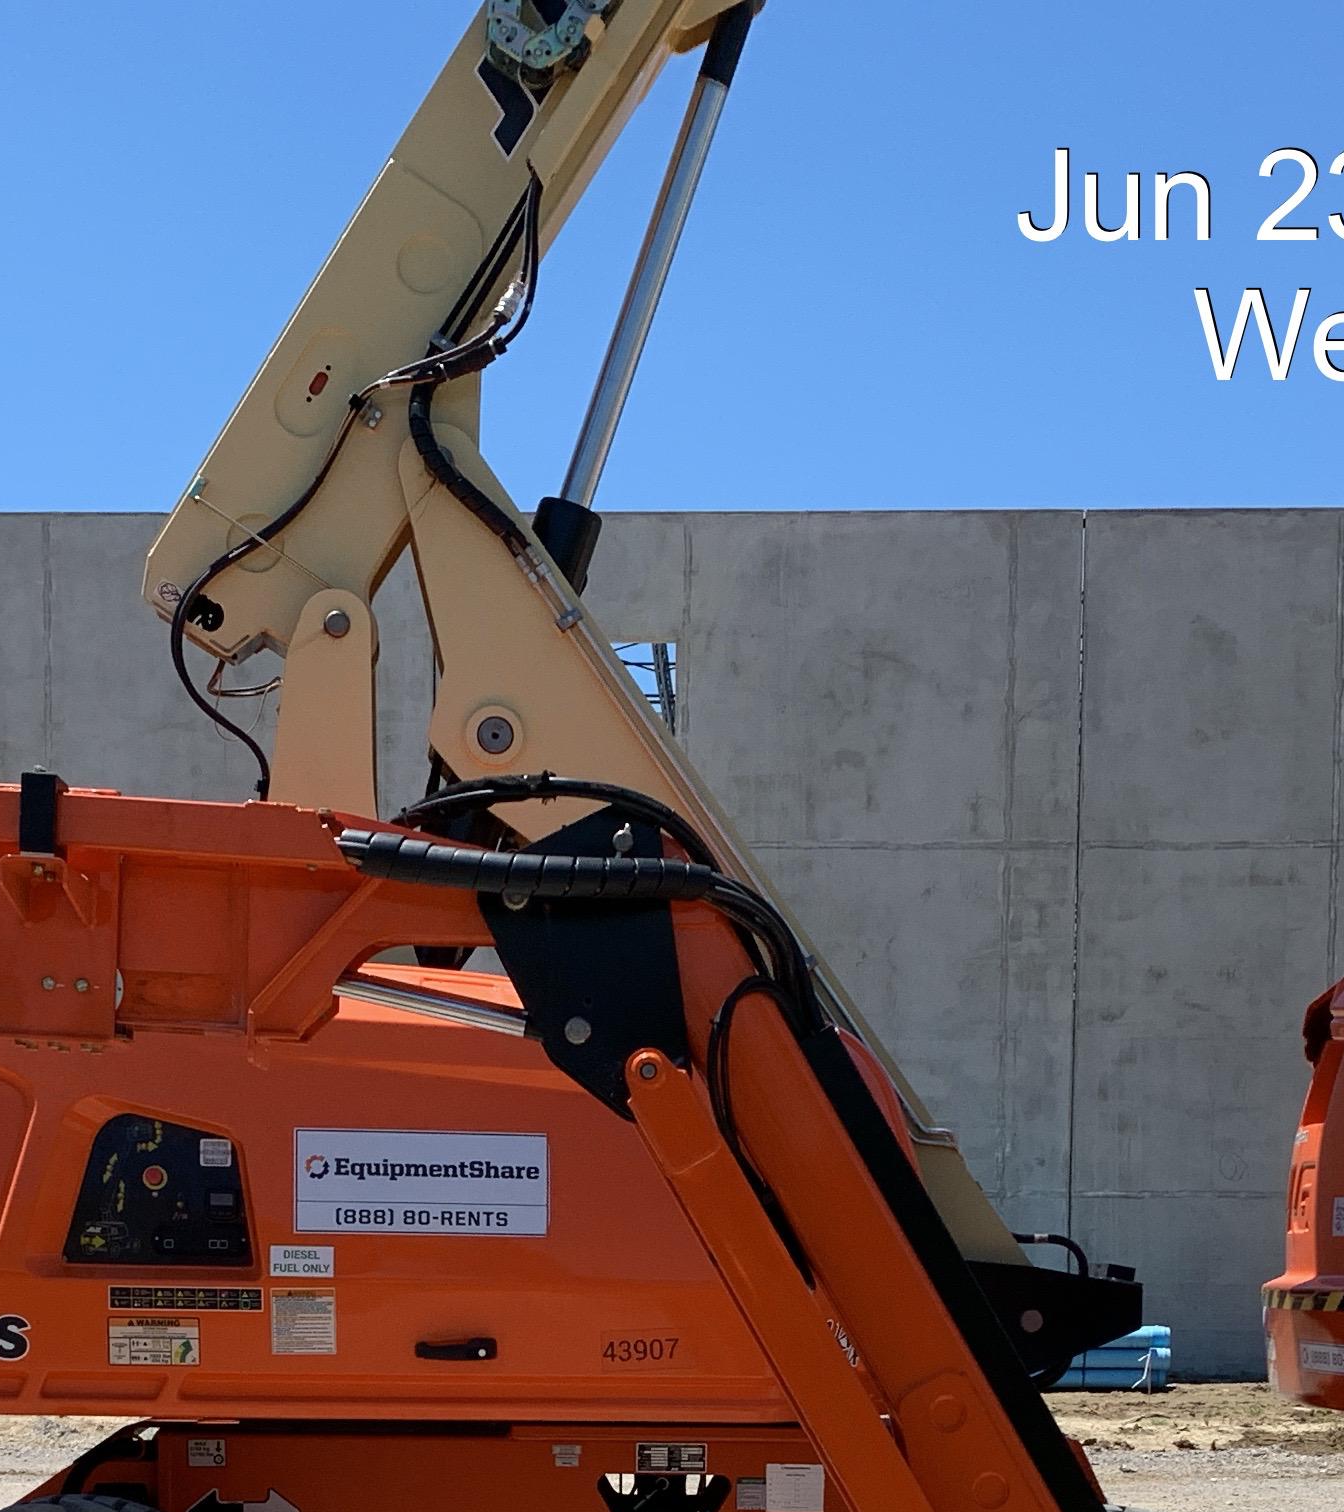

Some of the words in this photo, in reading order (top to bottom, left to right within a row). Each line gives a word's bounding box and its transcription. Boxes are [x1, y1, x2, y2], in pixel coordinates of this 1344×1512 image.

[334, 1157, 540, 1181] EquipmentShare
[336, 1208, 394, 1226] (888)
[403, 1210, 509, 1227] 80-RENTS
[283, 1249, 321, 1260] DIESEL
[273, 1263, 299, 1273] FUEL
[302, 1263, 330, 1274] ONLY
[602, 1338, 680, 1362] 43907
